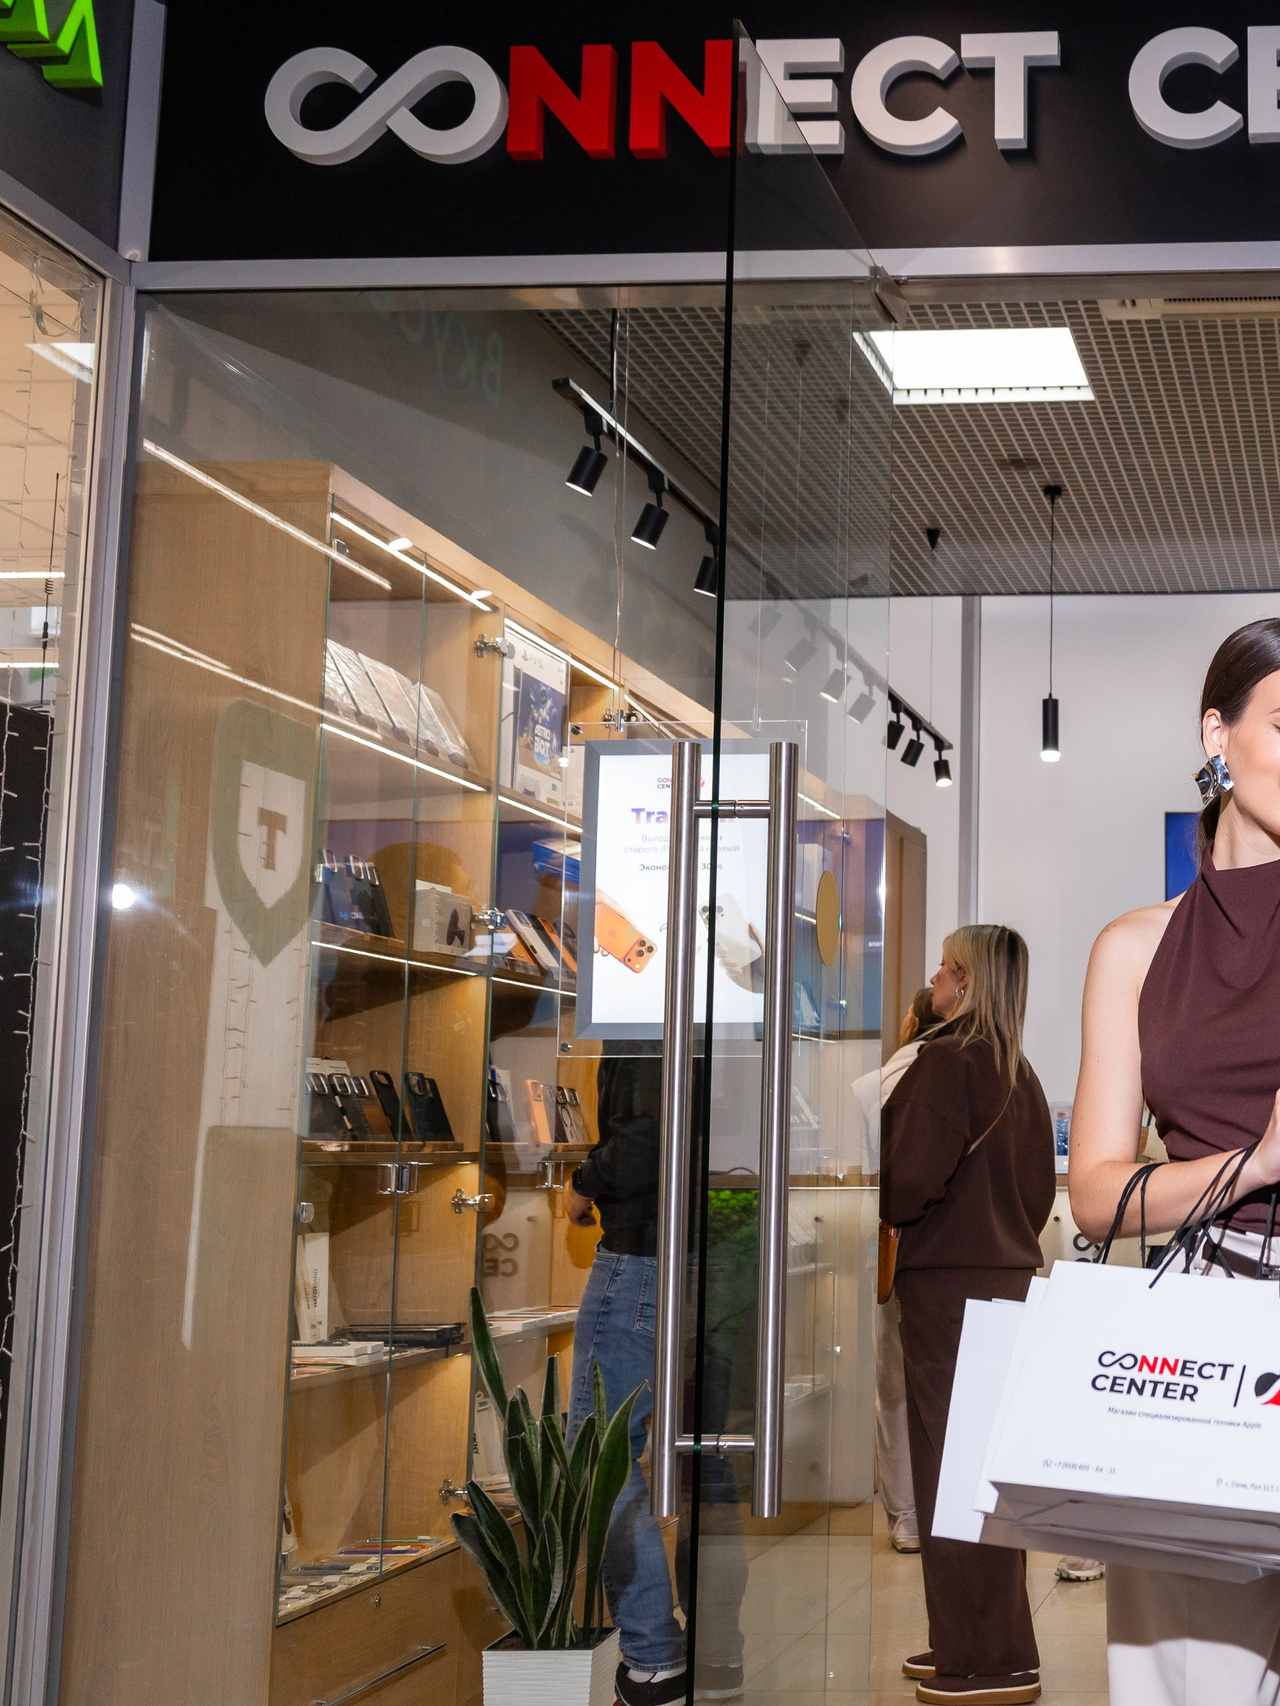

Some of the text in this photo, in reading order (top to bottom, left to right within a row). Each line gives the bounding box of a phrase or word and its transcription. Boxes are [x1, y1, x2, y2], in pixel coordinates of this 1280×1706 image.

[265, 30, 1061, 165] CONNECT
[624, 845, 658, 854] старого
[1098, 1350, 1234, 1381] CONNECT
[1090, 1374, 1199, 1402] CENTER
[1107, 1406, 1262, 1430] Магазин специализированной техники Apple
